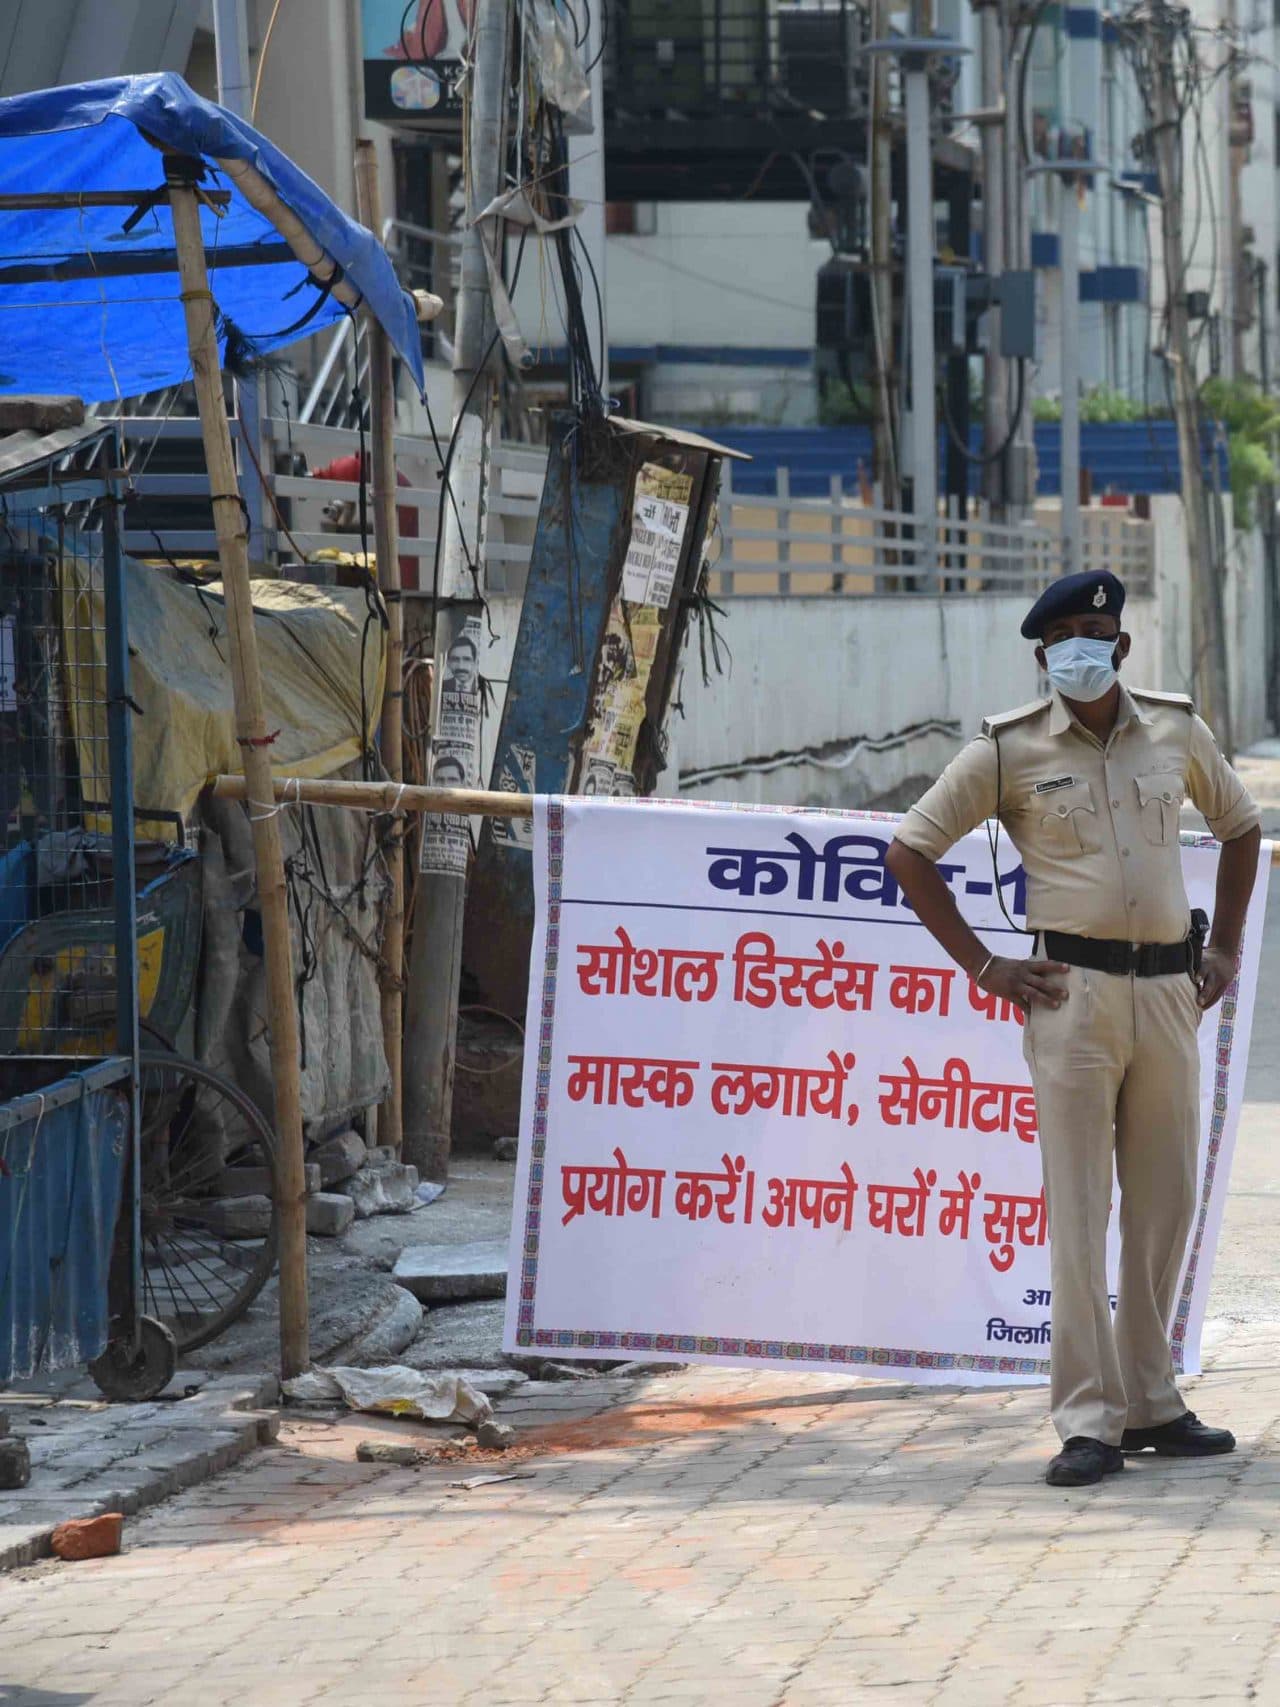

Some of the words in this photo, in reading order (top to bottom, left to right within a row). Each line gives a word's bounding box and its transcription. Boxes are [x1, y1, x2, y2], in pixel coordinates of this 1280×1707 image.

[577, 927, 722, 1002] सोशल
[733, 932, 879, 1012] डिस्टेंस
[889, 965, 956, 1016] का
[568, 1055, 700, 1109] मास्क
[711, 1051, 860, 1127] लगायें,
[561, 1148, 665, 1225] प्रयोग
[675, 1155, 755, 1225] करें।
[762, 1163, 860, 1231] अपने
[868, 1168, 937, 1237] घरों
[939, 1171, 981, 1239] में
